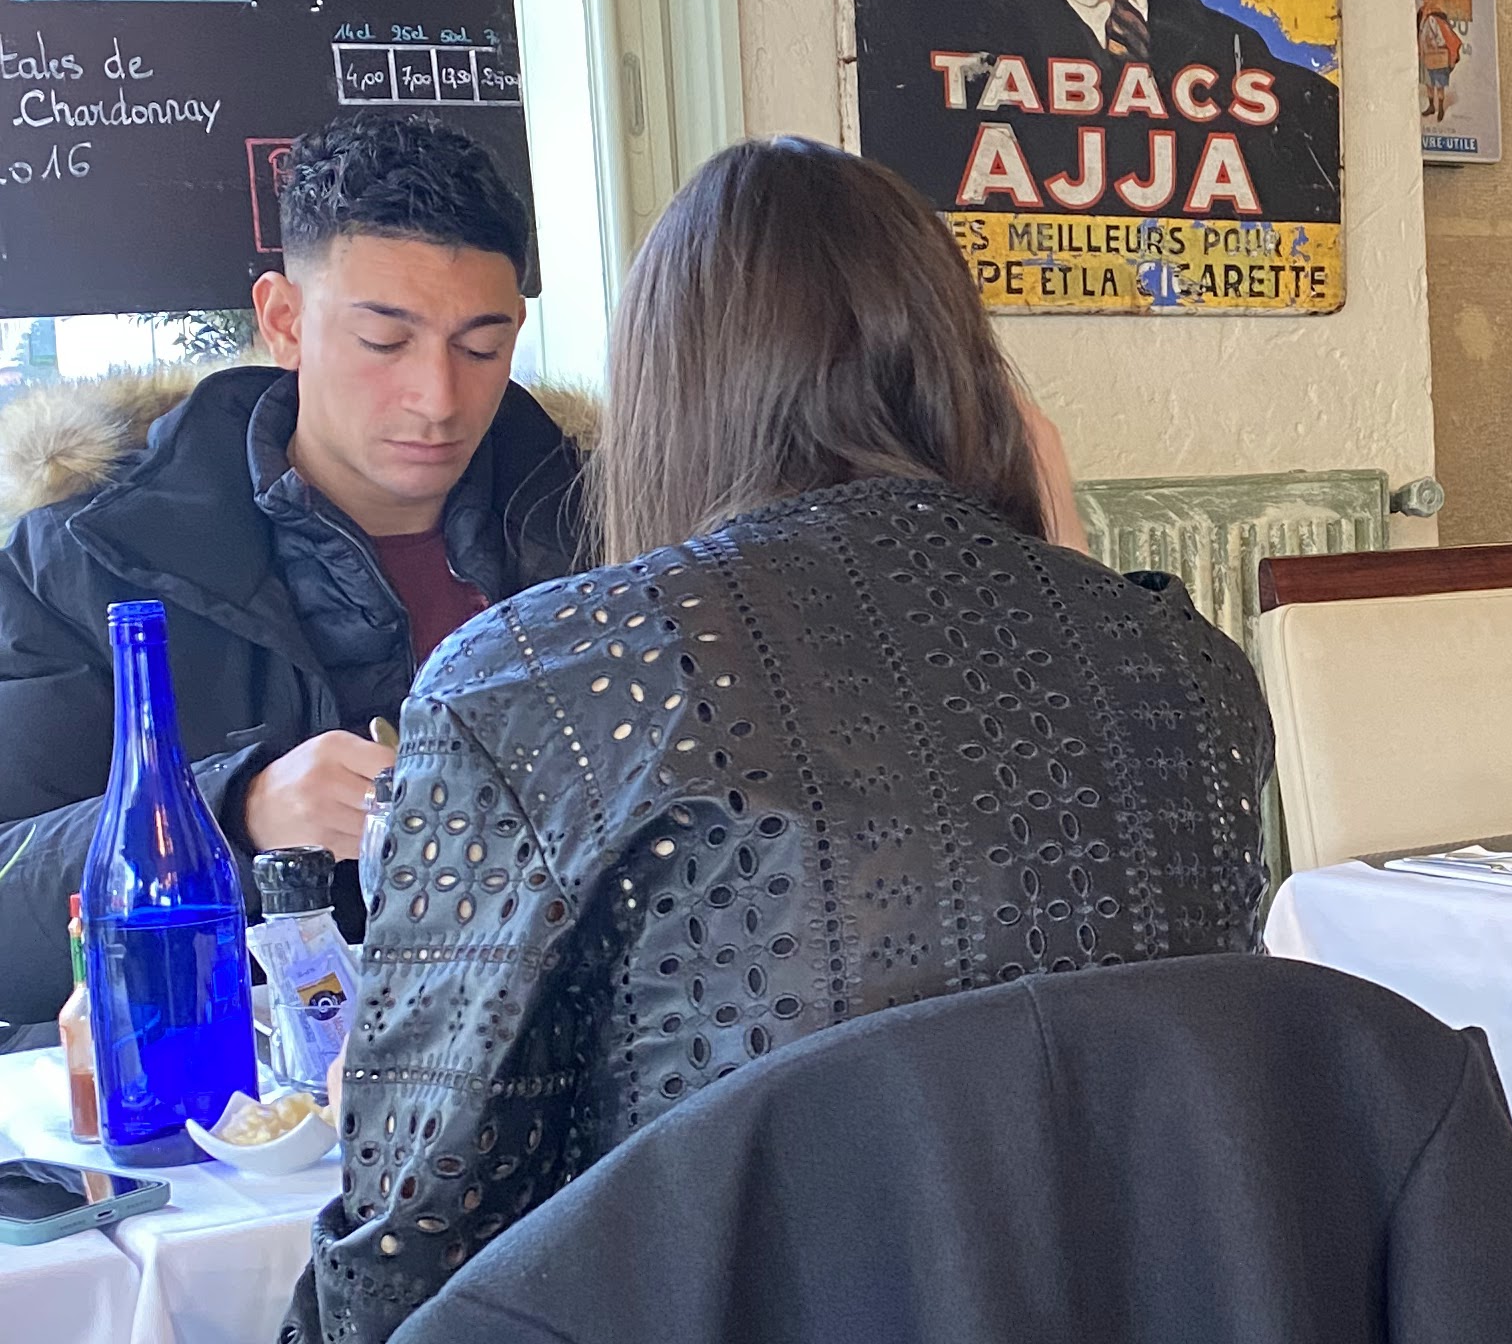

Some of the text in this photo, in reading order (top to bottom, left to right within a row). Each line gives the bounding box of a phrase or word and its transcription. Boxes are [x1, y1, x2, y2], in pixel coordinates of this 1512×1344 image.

[104, 37, 154, 80] de
[347, 63, 384, 92] 4,00
[402, 65, 432, 94] 7,00
[930, 50, 1280, 125] TABACS
[16, 86, 221, 134] Chardonnay
[0, 142, 92, 186] 016
[1422, 136, 1476, 151] VRE-UTILE
[955, 121, 1263, 215] AJJA
[952, 219, 1283, 257] ES MEILLEURS POUR
[976, 259, 1024, 295] PE
[1136, 259, 1326, 298] CIGARETTE
